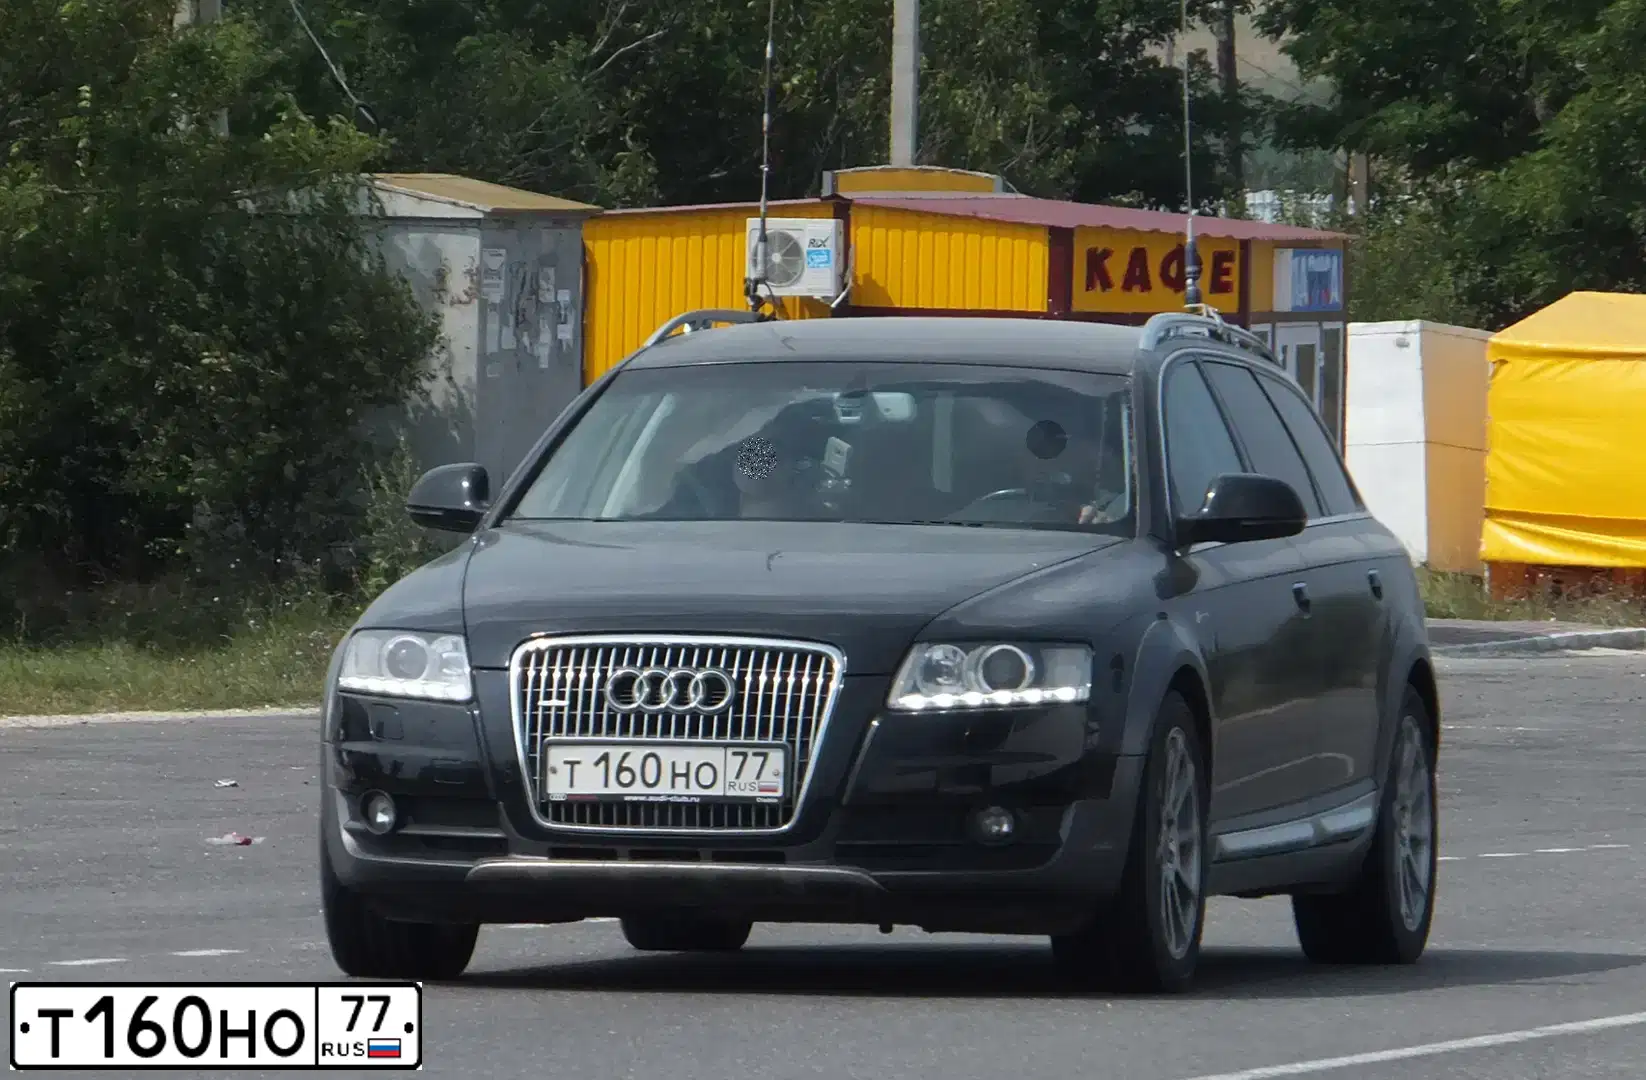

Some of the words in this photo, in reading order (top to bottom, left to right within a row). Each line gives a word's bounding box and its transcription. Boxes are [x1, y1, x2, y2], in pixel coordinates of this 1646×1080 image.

[1084, 245, 1236, 294] КАФЕ
[731, 751, 769, 780] 77
[727, 781, 757, 792] RUS
